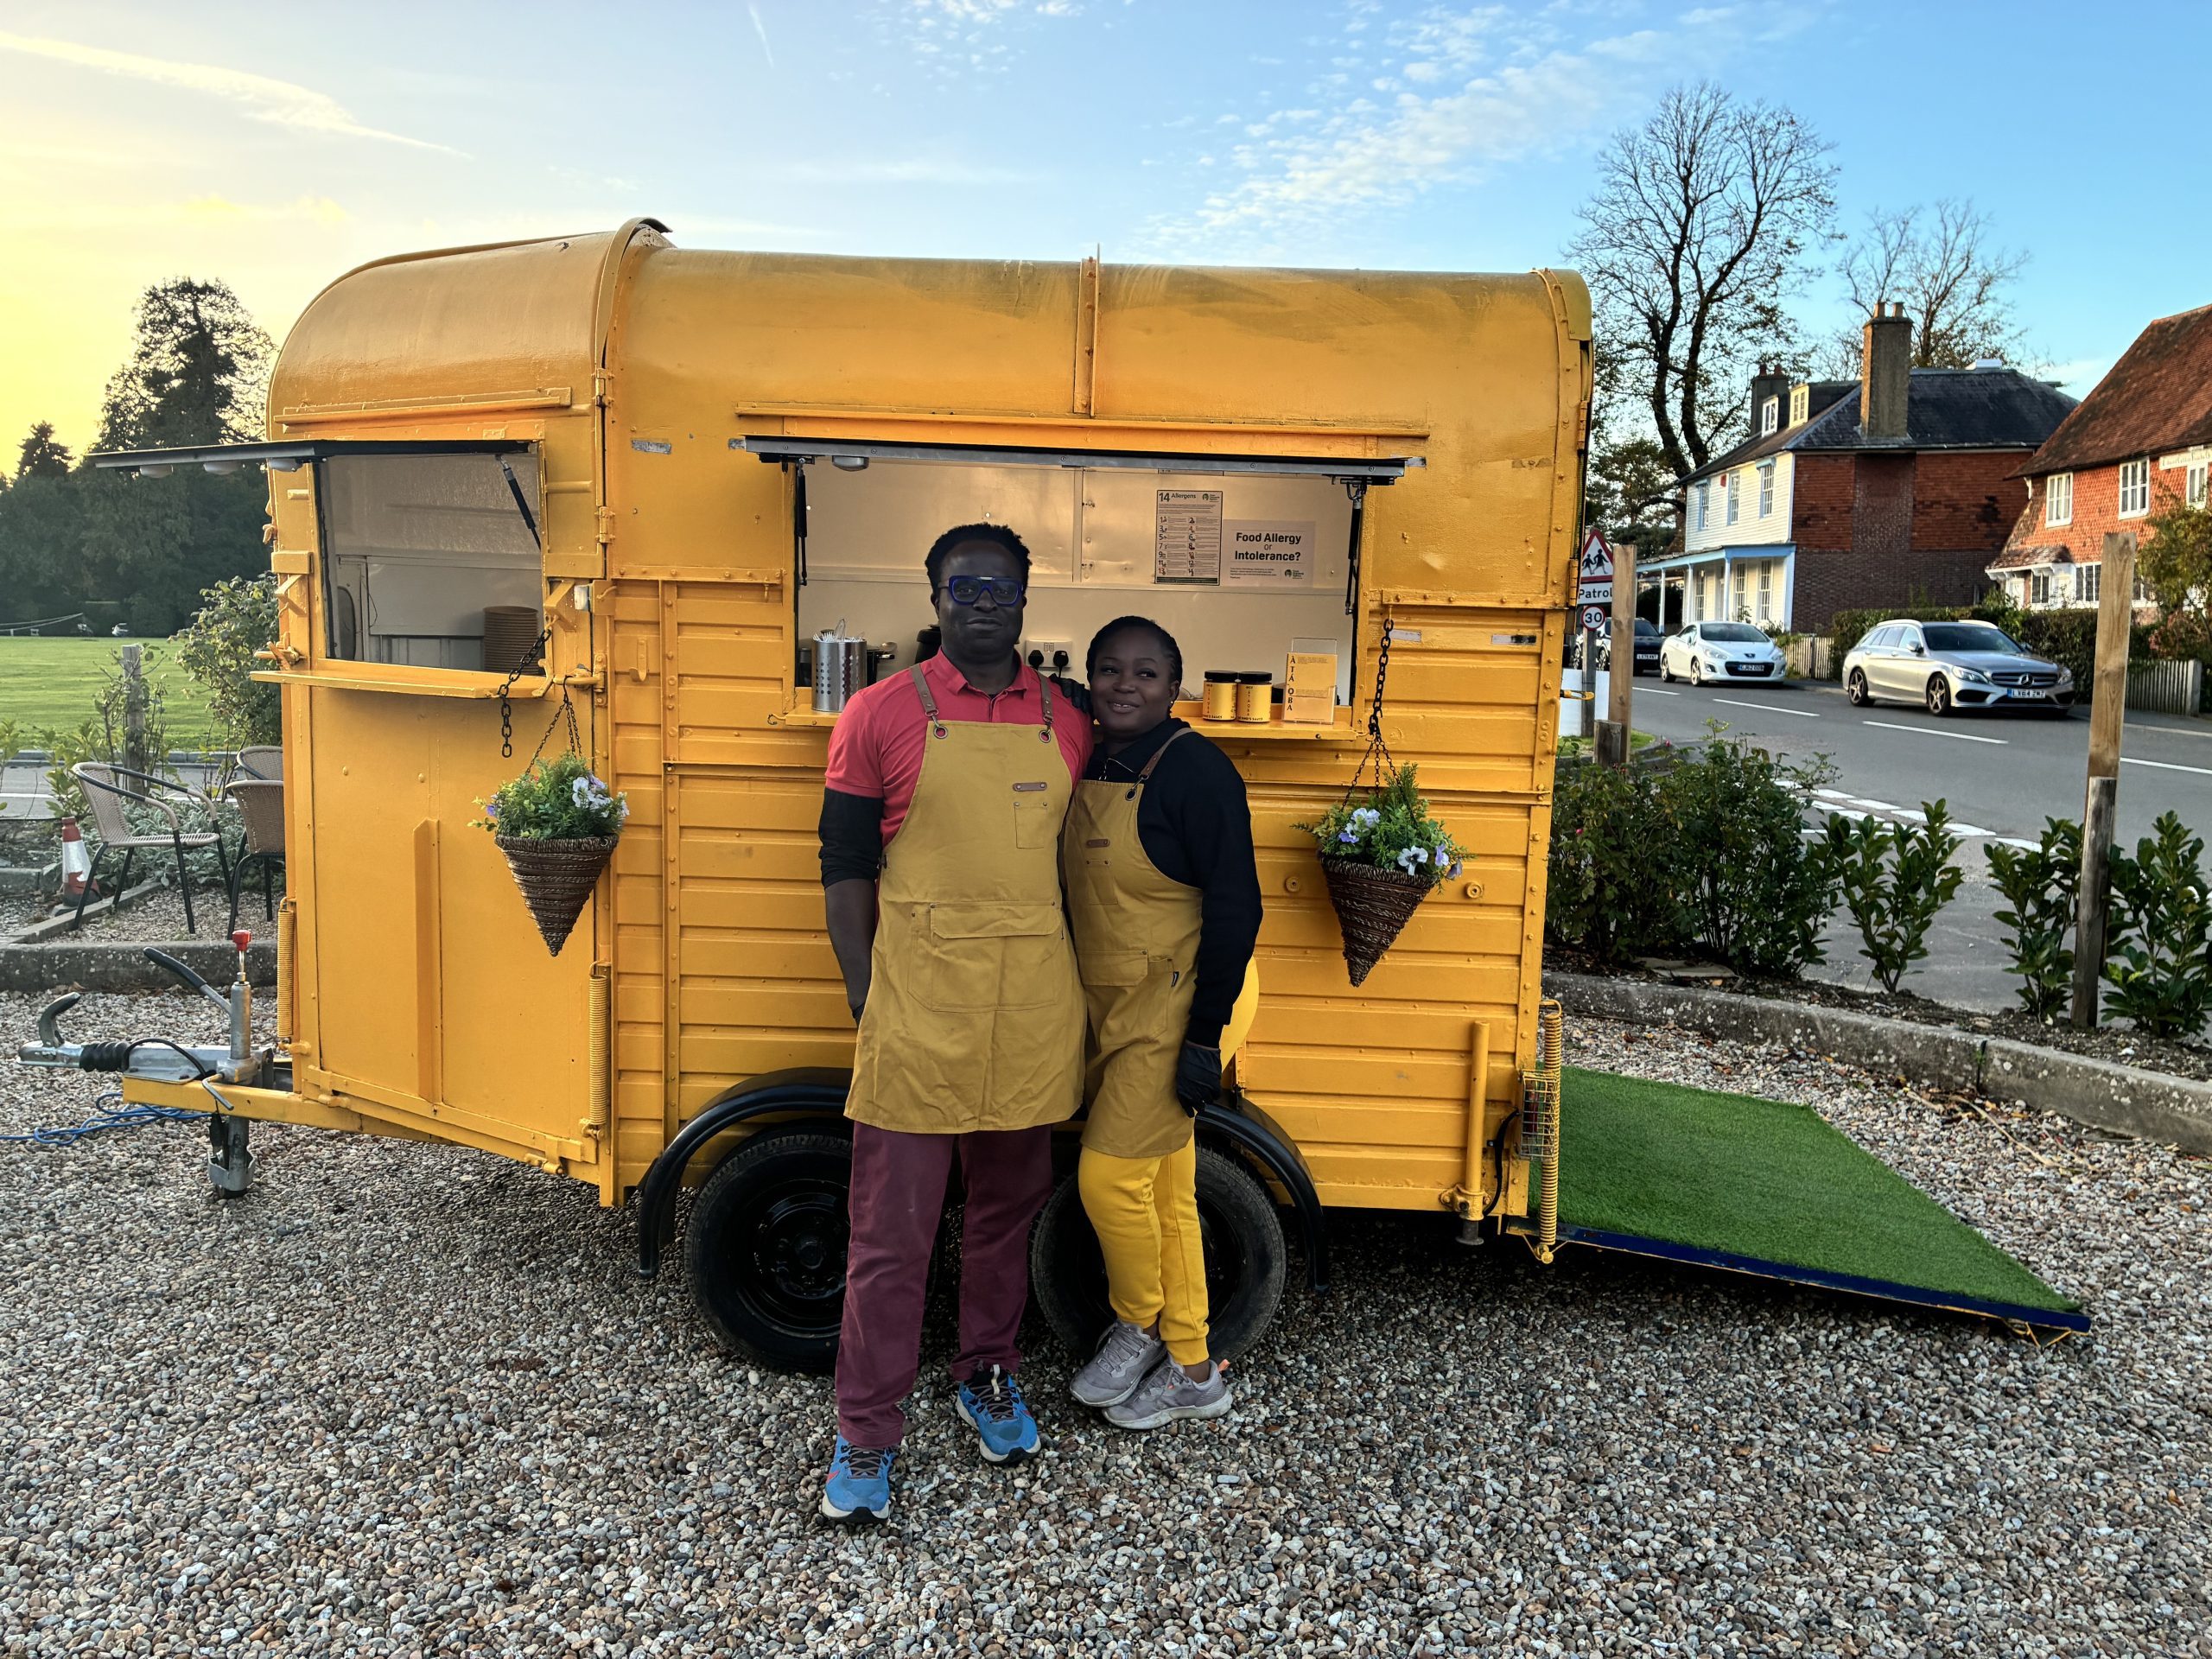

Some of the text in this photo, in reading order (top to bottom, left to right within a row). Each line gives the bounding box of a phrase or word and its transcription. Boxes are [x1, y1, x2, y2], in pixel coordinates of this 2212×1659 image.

[1159, 493, 1170, 502] 14
[1236, 532, 1301, 544] Food Allergy
[1235, 550, 1301, 561] Intolerance?
[1579, 588, 1612, 599] Patrol
[1585, 612, 1603, 623] 30
